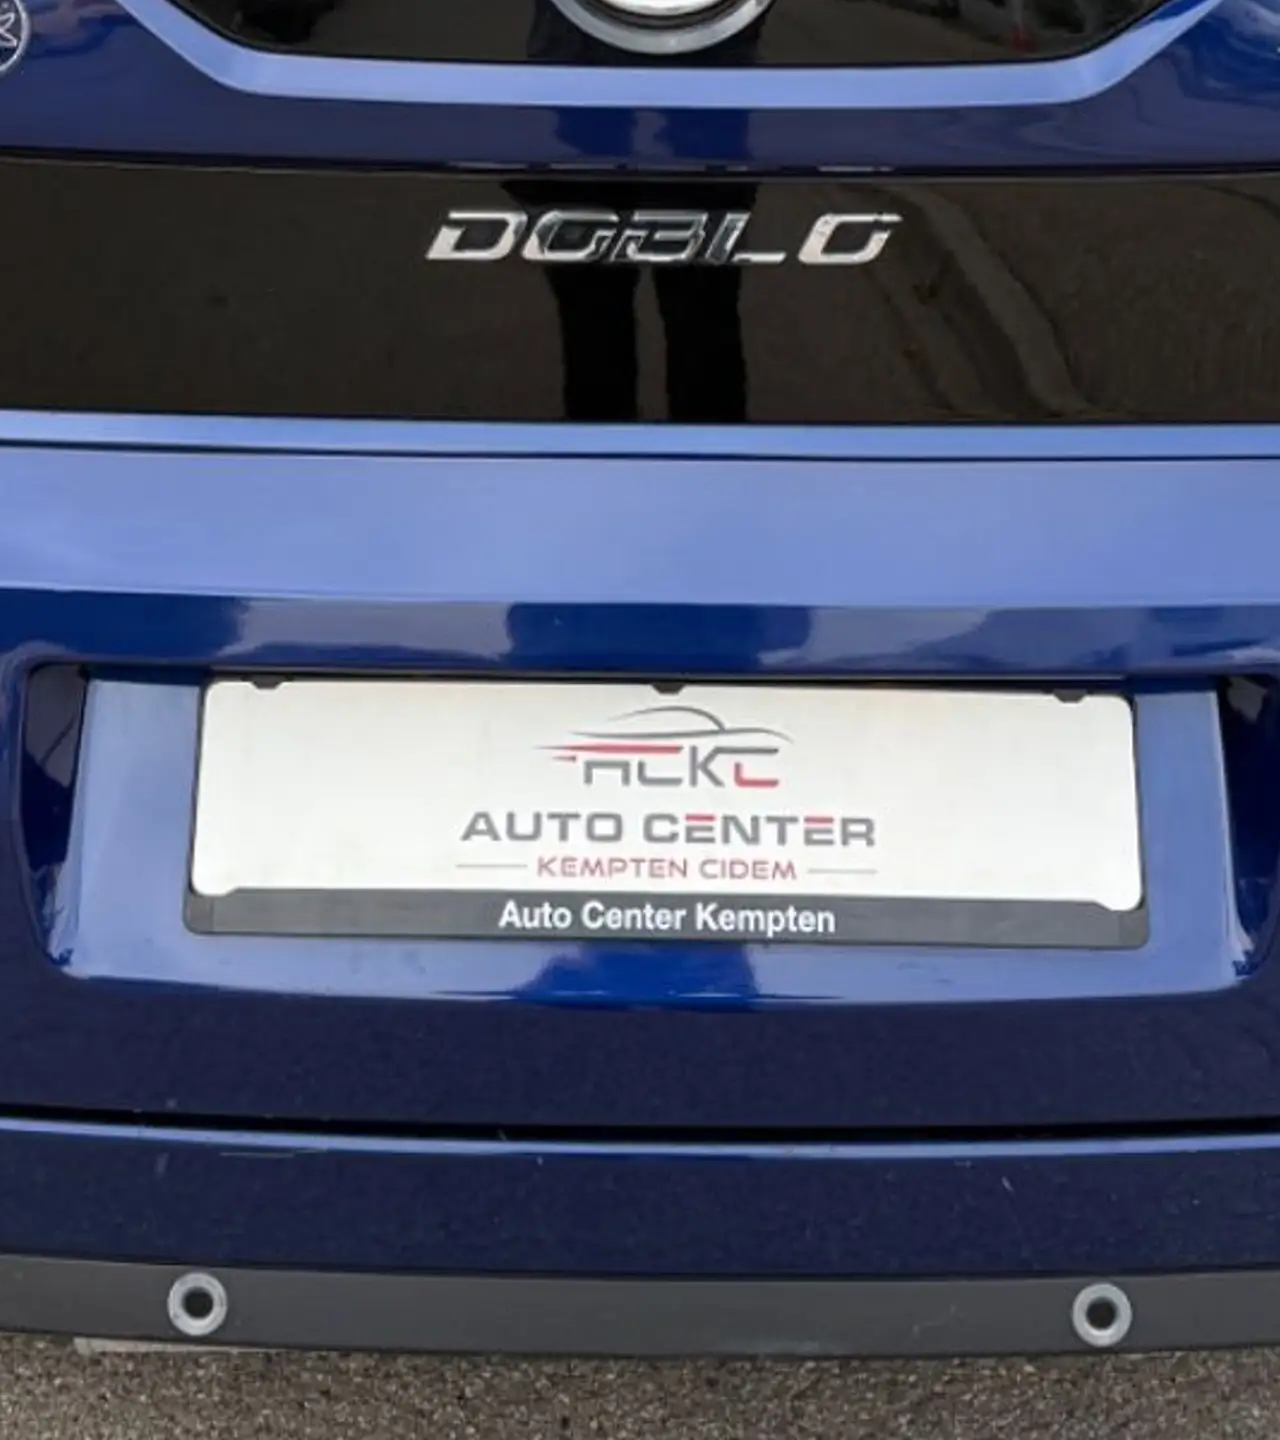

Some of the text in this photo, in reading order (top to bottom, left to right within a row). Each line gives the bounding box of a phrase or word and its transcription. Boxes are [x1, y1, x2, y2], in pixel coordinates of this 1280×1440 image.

[424, 209, 905, 266] DOBLO
[459, 811, 877, 848] AUTO CENTER
[536, 856, 798, 881] KEMPTEN CIDEM
[498, 900, 836, 938] Auto Center Kempten
